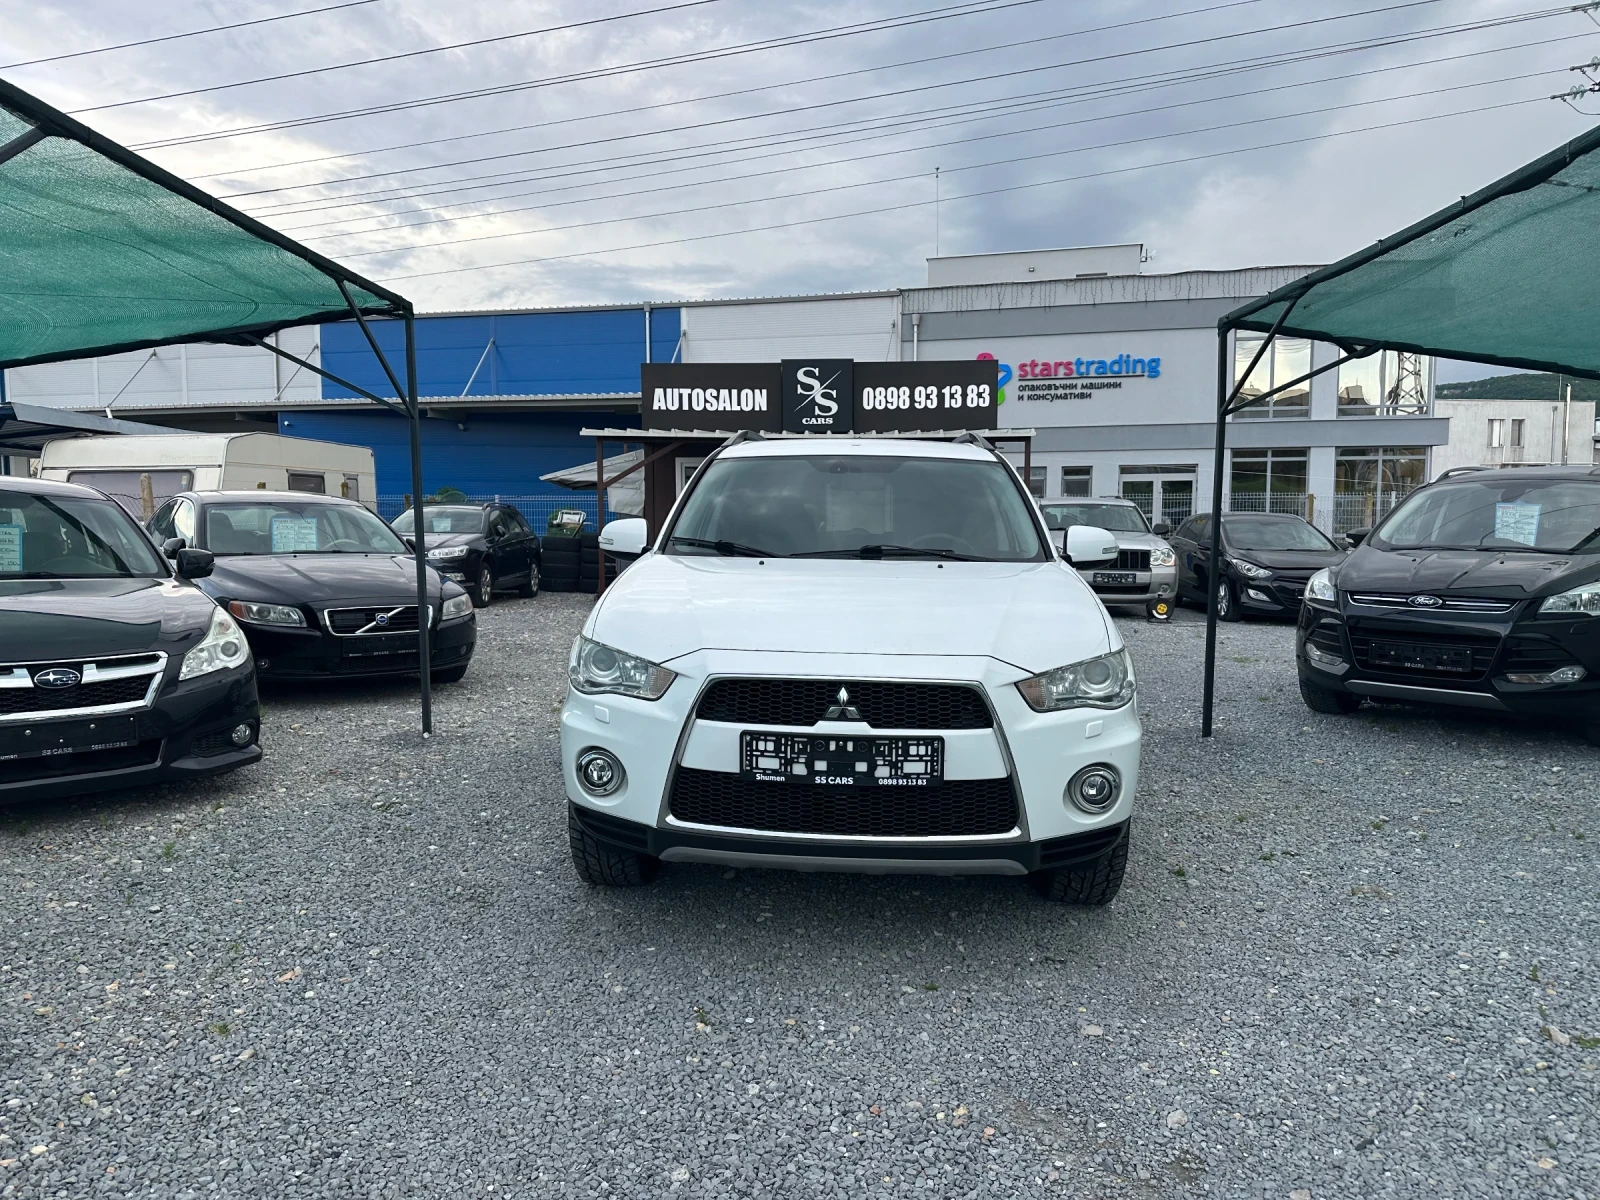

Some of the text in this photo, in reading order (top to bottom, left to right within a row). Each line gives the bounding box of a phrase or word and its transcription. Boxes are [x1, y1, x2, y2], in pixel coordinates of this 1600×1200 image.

[1018, 354, 1161, 378] starstrading
[1018, 381, 1122, 392] опаковъчни машини
[652, 388, 767, 411] AUTOSALON
[862, 384, 990, 410] 0898 93 13 83
[1018, 391, 1092, 402] и консумативи
[802, 417, 833, 425] CARS
[755, 773, 786, 782] Shumen
[814, 776, 827, 784] SS
[828, 776, 854, 785] CARS
[878, 778, 897, 786] 0898
[898, 778, 907, 786] 93
[917, 778, 927, 786] 83
